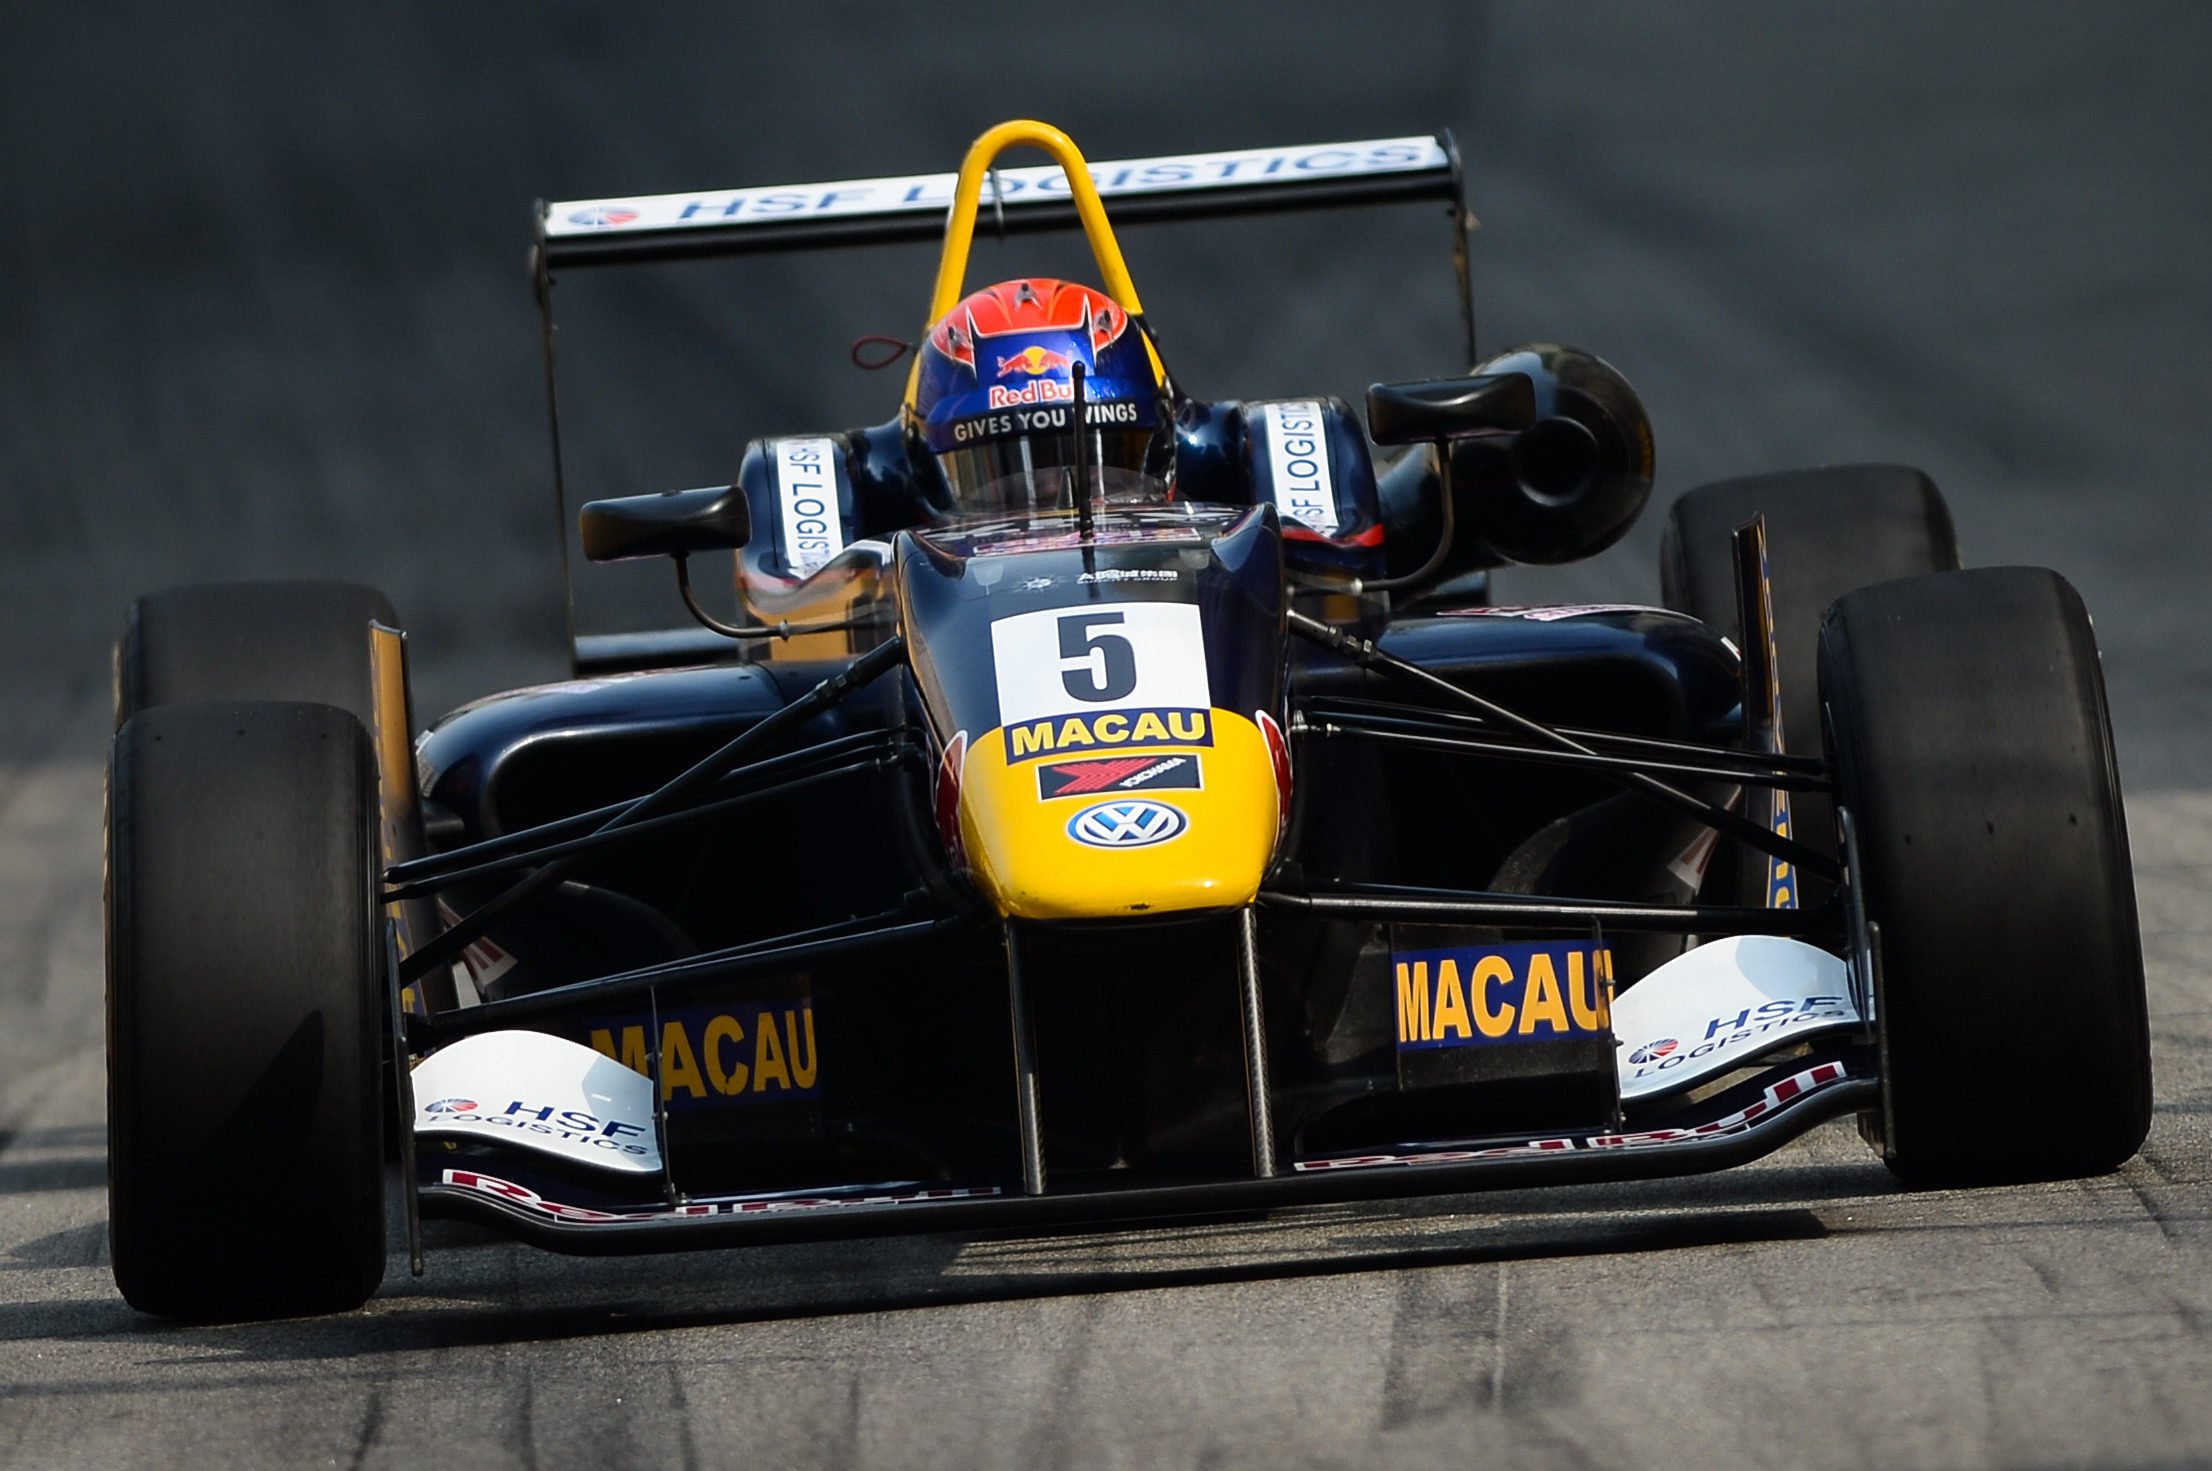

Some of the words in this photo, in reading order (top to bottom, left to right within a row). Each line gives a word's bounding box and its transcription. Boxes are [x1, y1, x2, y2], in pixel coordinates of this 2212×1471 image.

[678, 187, 875, 219] HSF
[989, 379, 1036, 408] Red
[954, 415, 1011, 441] GIVES
[1018, 408, 1066, 430] YOU
[789, 444, 822, 475] SF
[1056, 611, 1137, 702] 5
[1012, 711, 1206, 757] MACAU
[1396, 948, 1614, 1043] MACAU
[1704, 996, 1843, 1041] HSF
[1634, 1010, 1845, 1079] LOGISTICS
[428, 1114, 647, 1155] LOGISTICS
[503, 1101, 646, 1138] HSF
